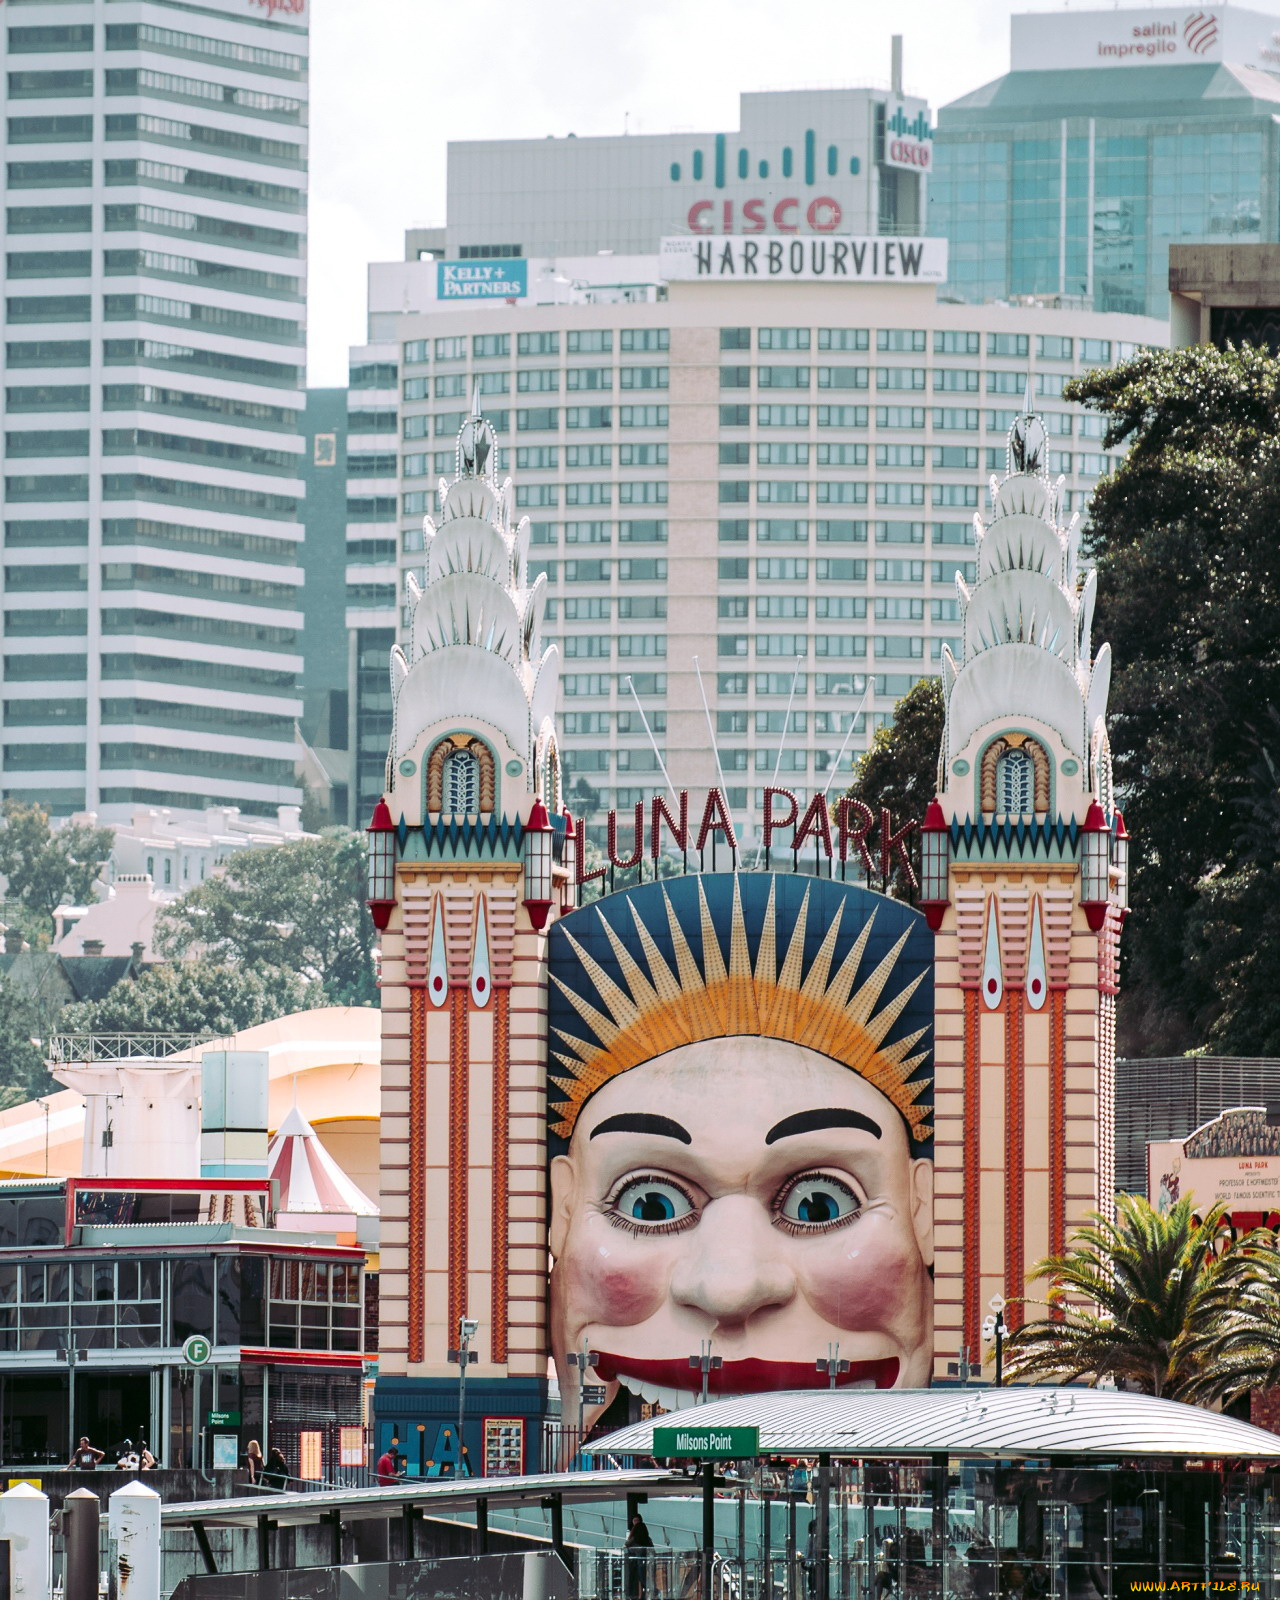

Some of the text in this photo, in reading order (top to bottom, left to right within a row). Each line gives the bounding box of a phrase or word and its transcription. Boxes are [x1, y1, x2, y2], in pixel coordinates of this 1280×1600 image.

[1133, 21, 1177, 37] salini
[1097, 40, 1177, 57] impregilo
[891, 140, 929, 167] CISCO
[687, 196, 842, 235] CISCO
[693, 240, 924, 277] HARBOURVIEW
[443, 281, 521, 296] PARTNERS
[575, 785, 918, 888] LUNA PARK
[1238, 1161, 1269, 1169] LUNA PARK
[1219, 1179, 1245, 1187] PROFESSOR
[1215, 1192, 1231, 1200] WORLD
[1234, 1191, 1251, 1199] FAMOUS
[193, 1343, 203, 1359] F
[676, 1432, 732, 1451] Milsons Point
